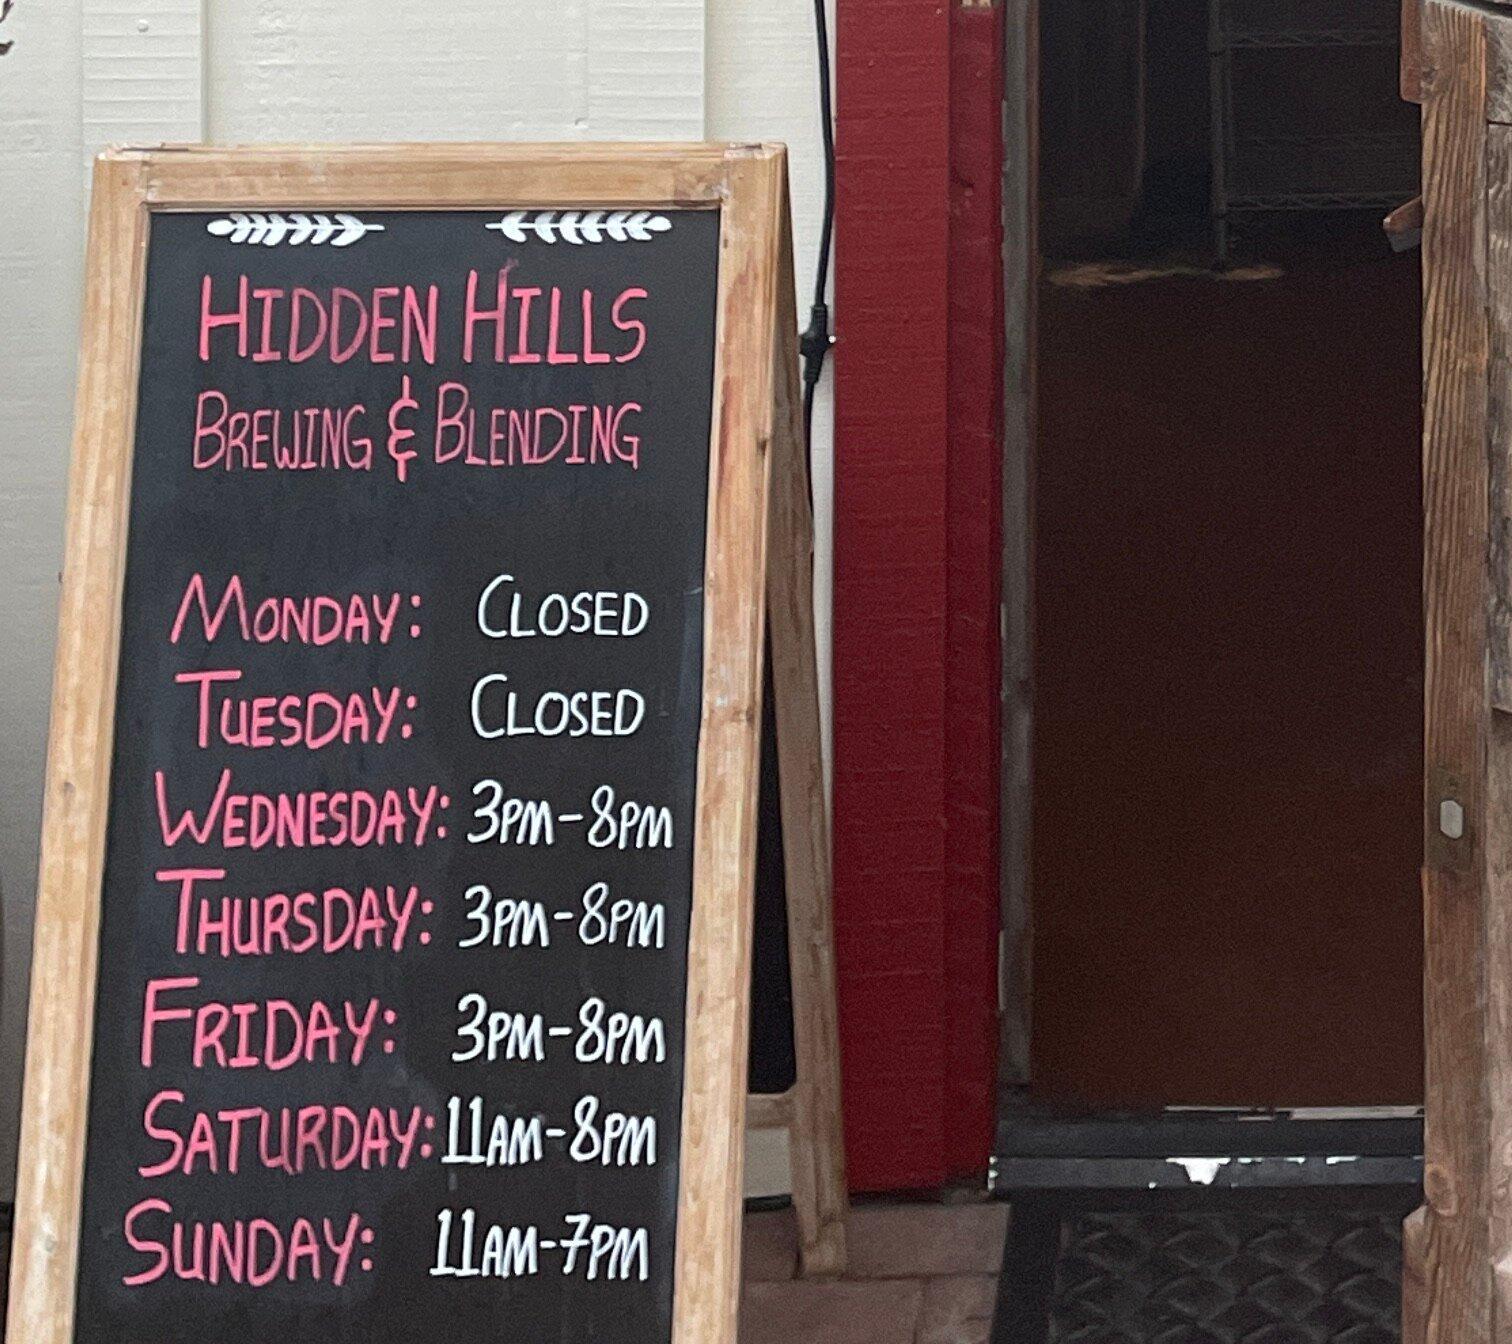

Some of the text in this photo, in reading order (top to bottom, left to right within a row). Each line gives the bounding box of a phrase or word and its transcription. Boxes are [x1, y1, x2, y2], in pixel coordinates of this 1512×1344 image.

[200, 271, 647, 364] HIDDEN HILLS
[195, 378, 640, 480] BREWING & BLENDING
[171, 574, 648, 644] MONDAY: CLOSED
[176, 670, 644, 748] TUESDAY: CLOSED
[156, 769, 672, 849] WEDNESDAY: 3PM-8PM
[156, 869, 663, 955] THURSDAY: 3PM-8PM
[142, 977, 664, 1069] FRIDAY: 3PM-8PM
[140, 1091, 655, 1177] SATURDAY: 11AM-8PM
[125, 1199, 647, 1285] SUNDAY: 11AM-7PM
